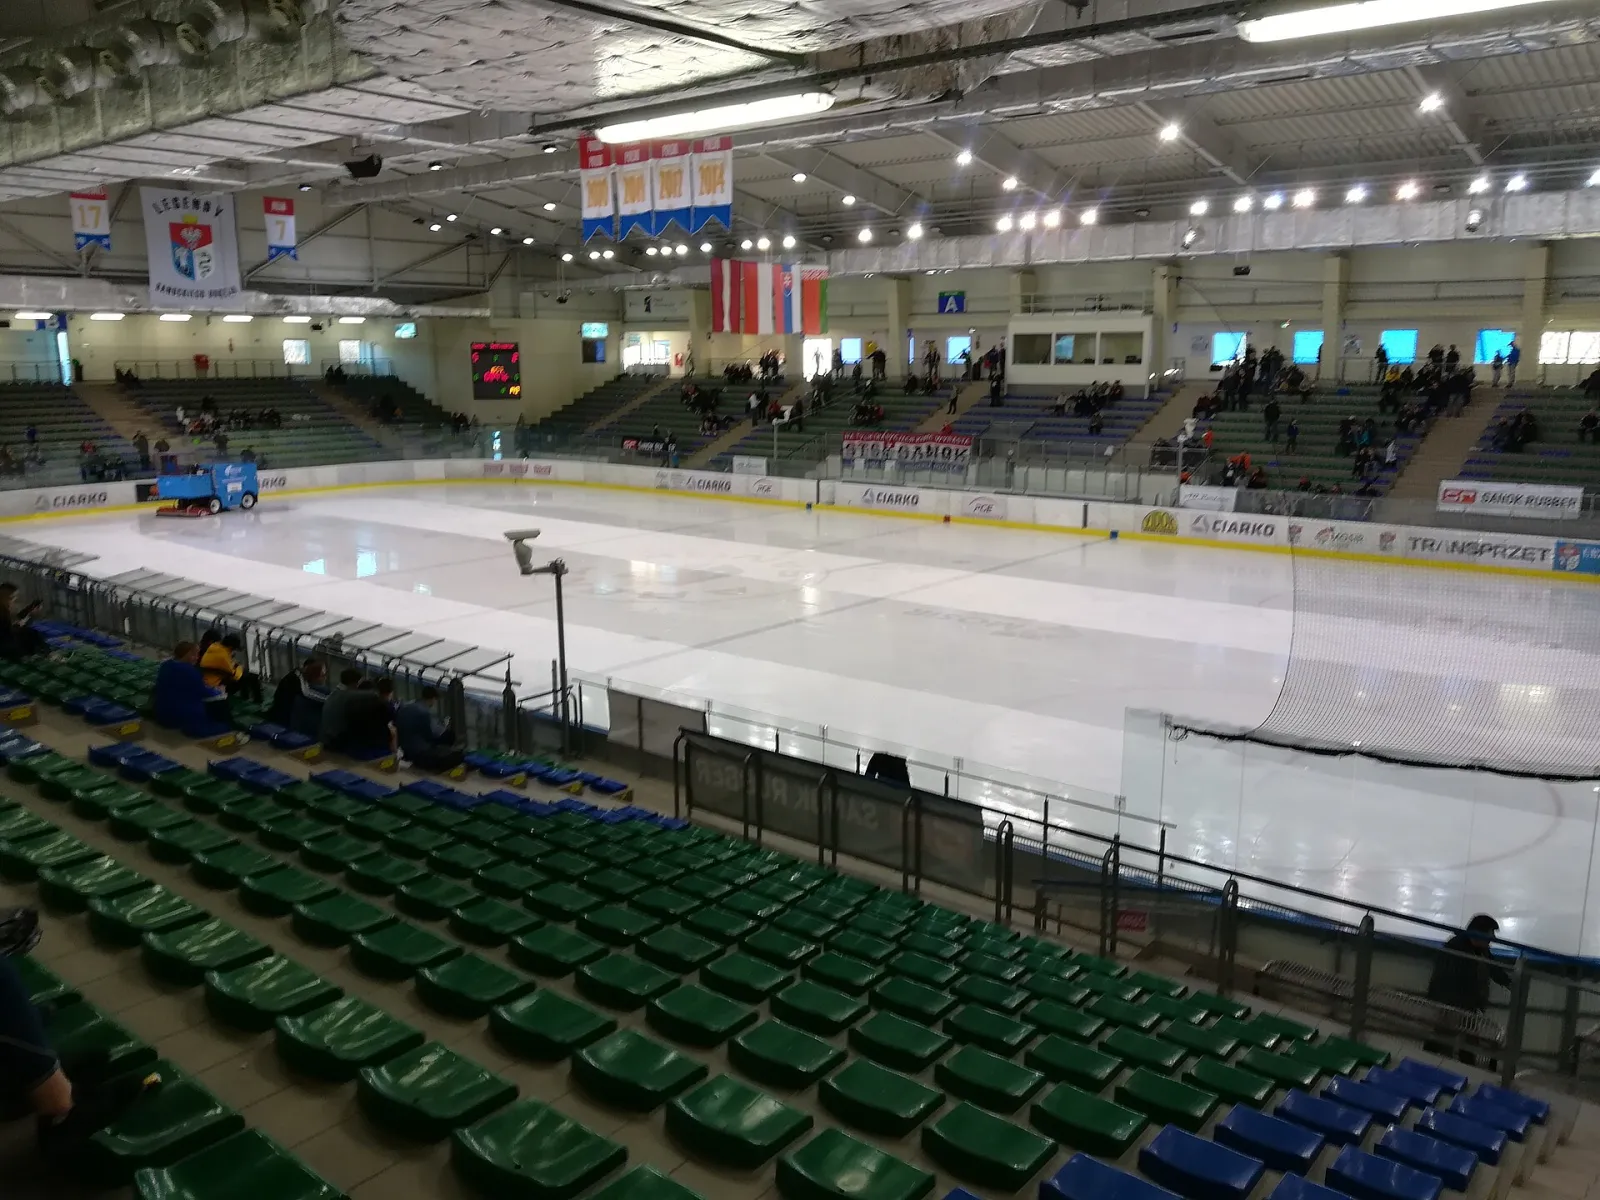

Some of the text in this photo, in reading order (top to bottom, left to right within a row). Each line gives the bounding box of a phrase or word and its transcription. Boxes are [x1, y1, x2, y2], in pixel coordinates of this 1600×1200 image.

[77, 204, 102, 229] 17
[275, 219, 288, 241] 7
[944, 294, 959, 314] A
[696, 478, 732, 493] CIARKO
[52, 491, 108, 509] CIARKO
[876, 491, 920, 507] CIARKO
[1480, 491, 1577, 509] SANOK RUBBER
[1211, 519, 1276, 538] CIARKO
